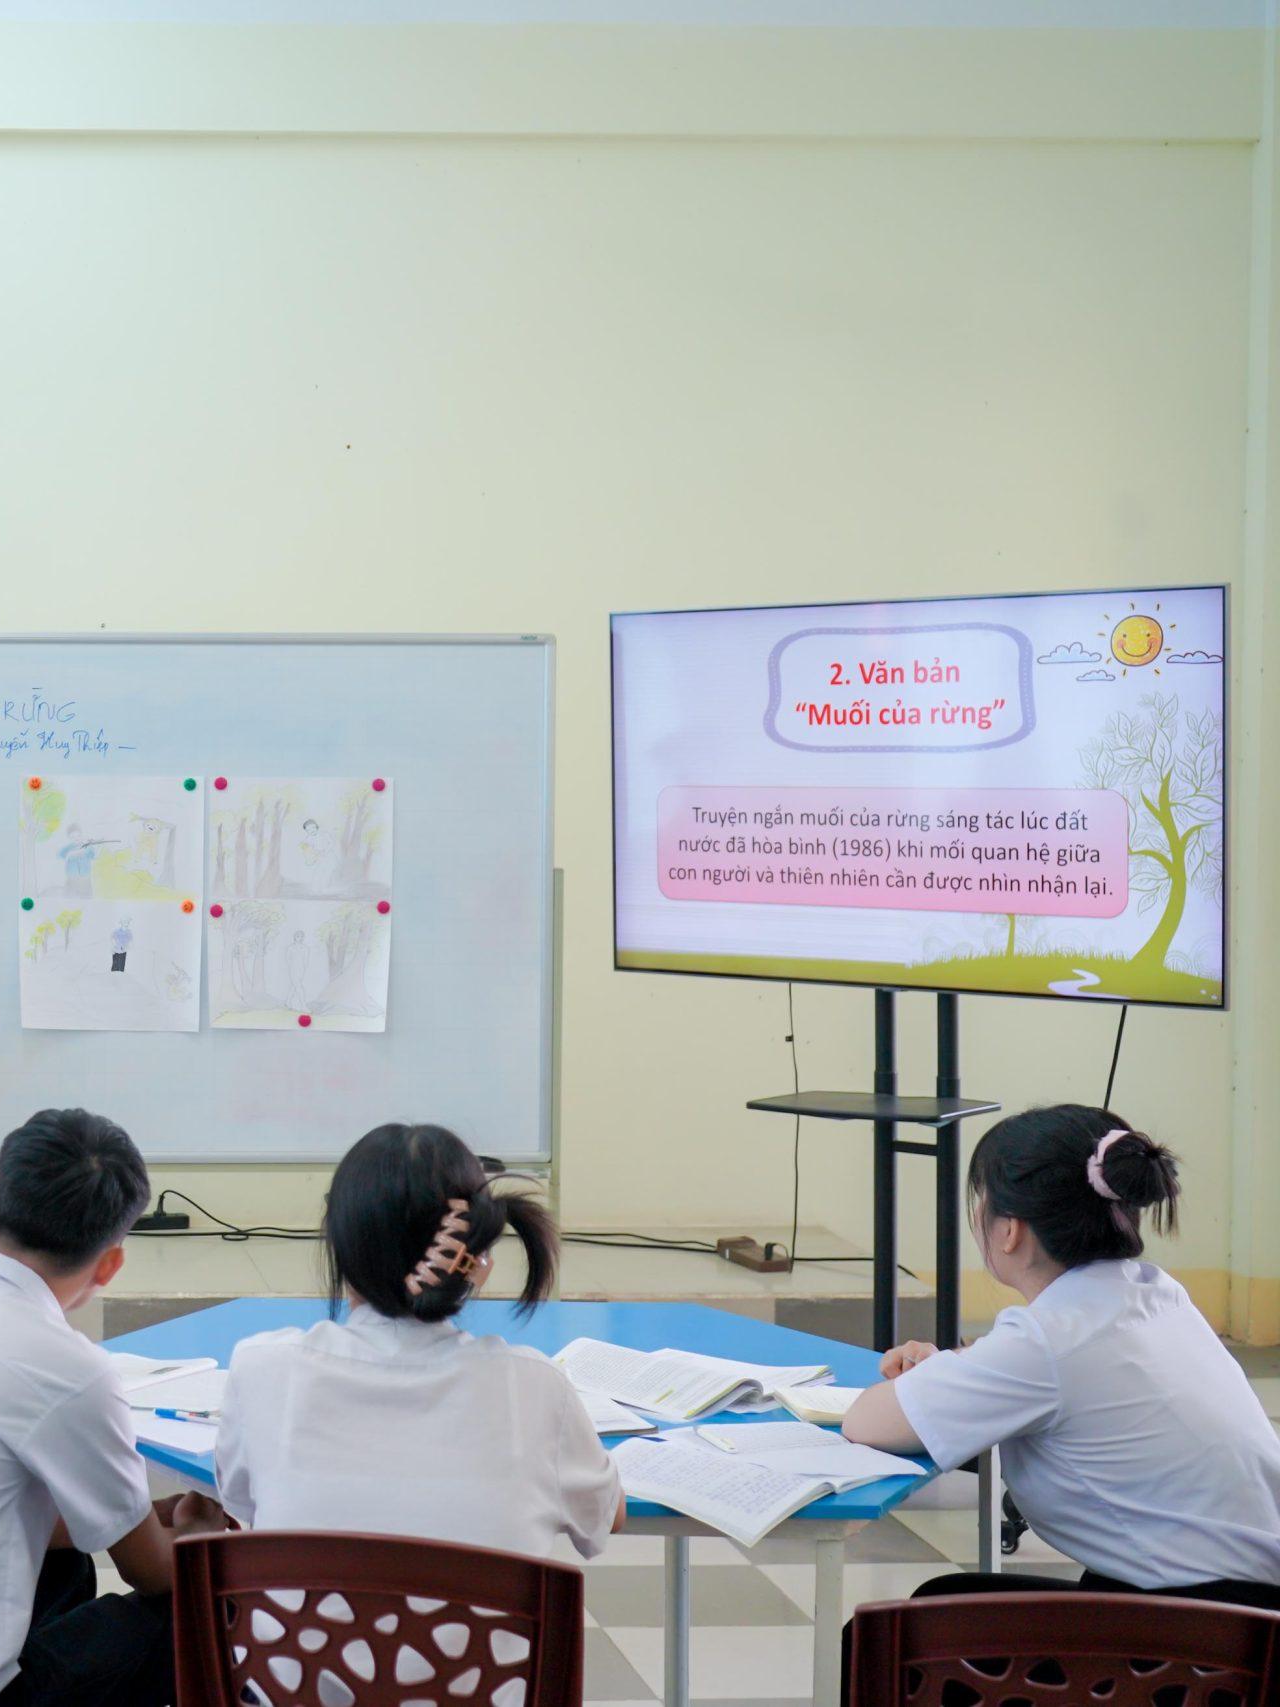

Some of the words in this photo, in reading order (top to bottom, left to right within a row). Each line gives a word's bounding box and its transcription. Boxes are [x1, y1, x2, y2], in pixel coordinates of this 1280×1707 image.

[830, 662, 851, 686] 2.
[858, 659, 905, 685] Văn
[913, 656, 961, 684] bản
[878, 699, 921, 725] của
[36, 731, 70, 759] Huy
[692, 806, 748, 828] Truyện
[753, 804, 794, 828] ngắn
[800, 806, 844, 827] muối
[850, 807, 880, 827] của
[886, 809, 930, 832] rừng
[936, 810, 979, 832] sáng
[986, 810, 1014, 830] tác
[1021, 810, 1049, 830] lúc
[1055, 809, 1088, 831] đất
[679, 835, 720, 853] nước
[726, 836, 746, 853] đã
[752, 837, 783, 855] hòa
[789, 837, 826, 856] bình
[832, 836, 891, 862] (1986)
[897, 840, 923, 858] khi
[930, 838, 965, 860] mối
[971, 846, 1019, 864] quan
[1026, 842, 1051, 865] hệ
[1056, 844, 1100, 867] giữa
[669, 867, 697, 880] con
[702, 865, 751, 885] người
[756, 866, 774, 884] và
[780, 867, 824, 885] thiên
[830, 868, 880, 888] nhiên
[886, 867, 917, 888] cần
[923, 871, 973, 893] được
[978, 872, 1021, 893] nhìn
[1028, 874, 1077, 897] nhận
[1084, 875, 1113, 898] lại.
